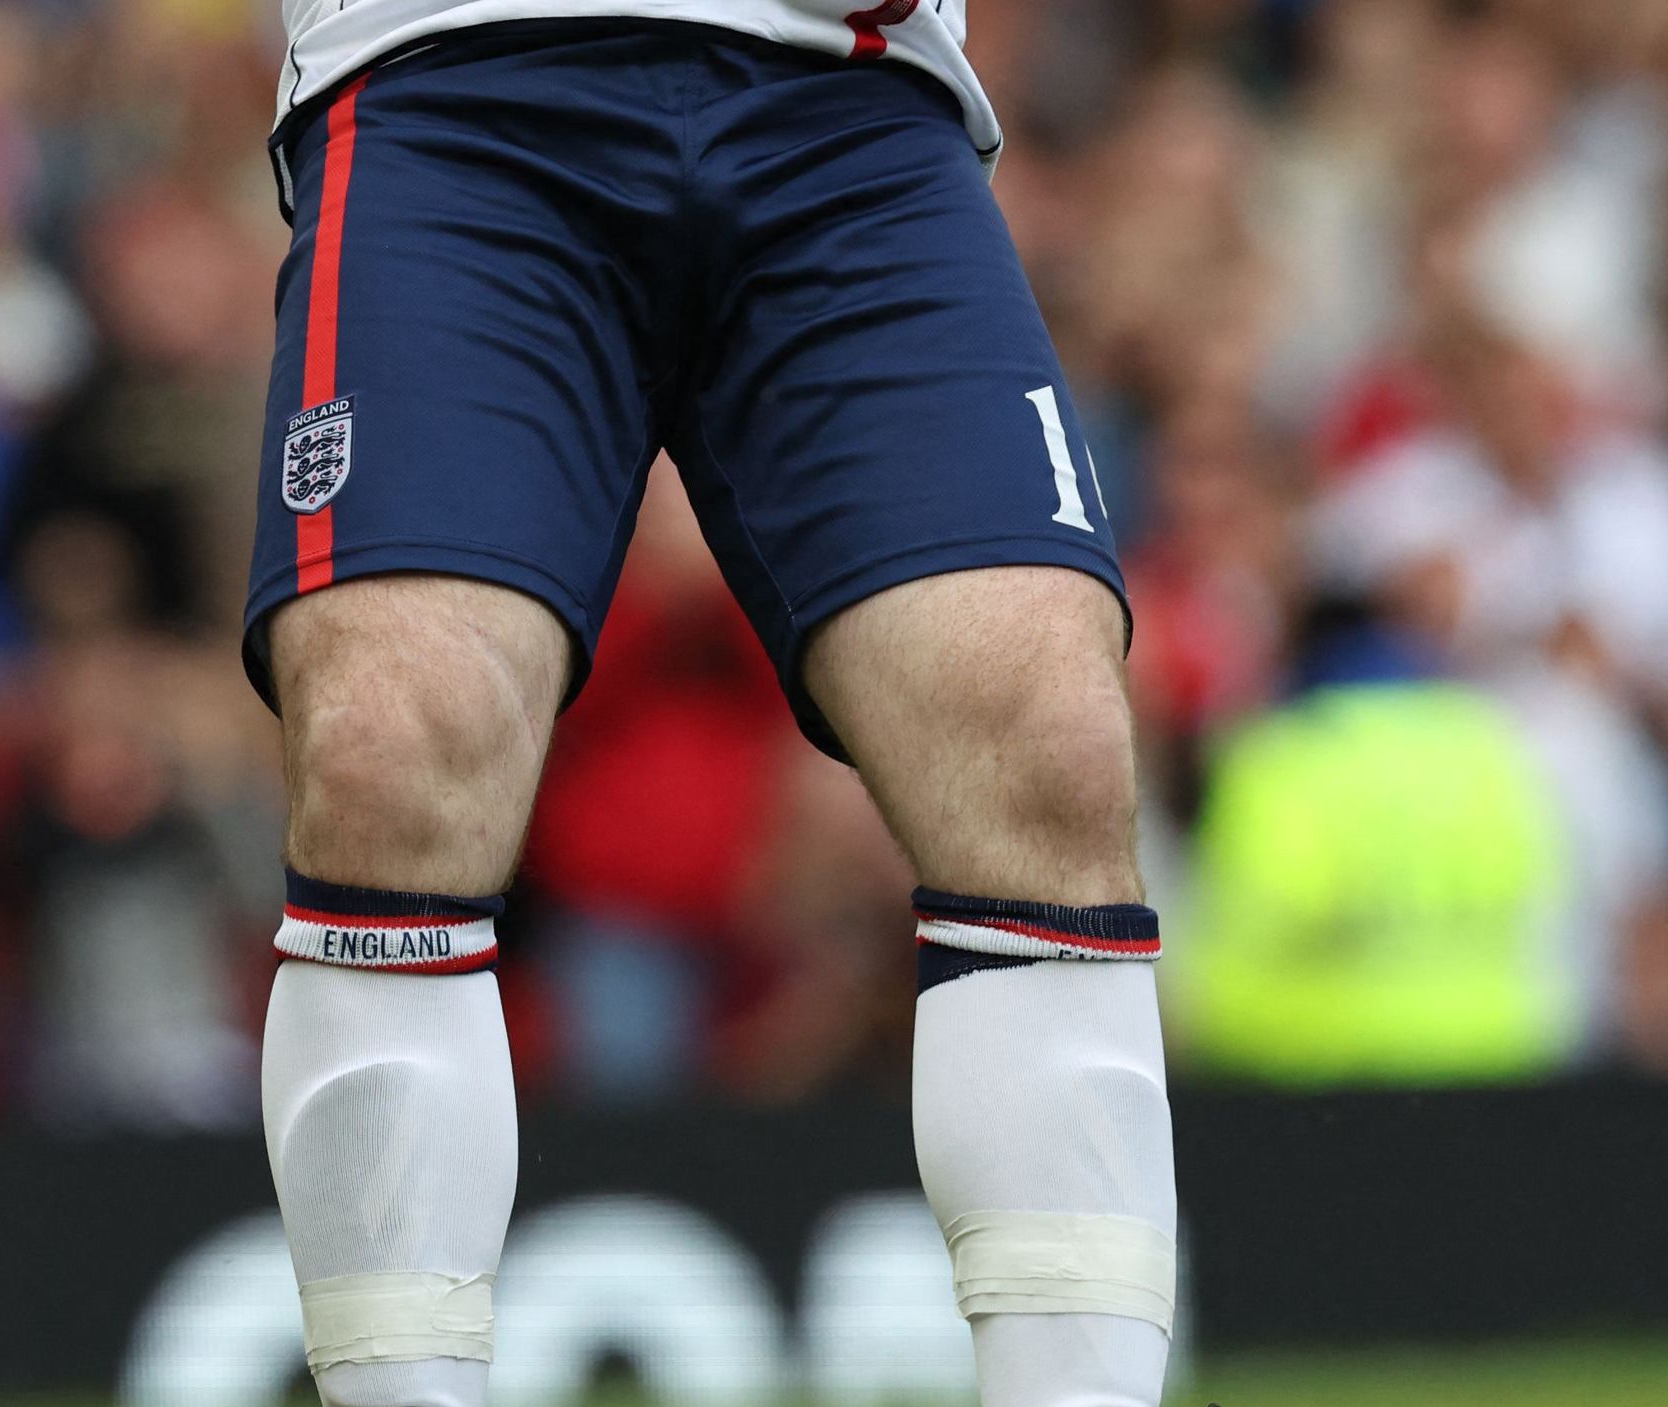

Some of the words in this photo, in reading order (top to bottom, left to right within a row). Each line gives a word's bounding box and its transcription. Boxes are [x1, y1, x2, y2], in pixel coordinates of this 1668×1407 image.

[289, 400, 350, 432] ENGLAND
[1025, 385, 1107, 533] 1
[323, 929, 451, 960] ENGLAND
